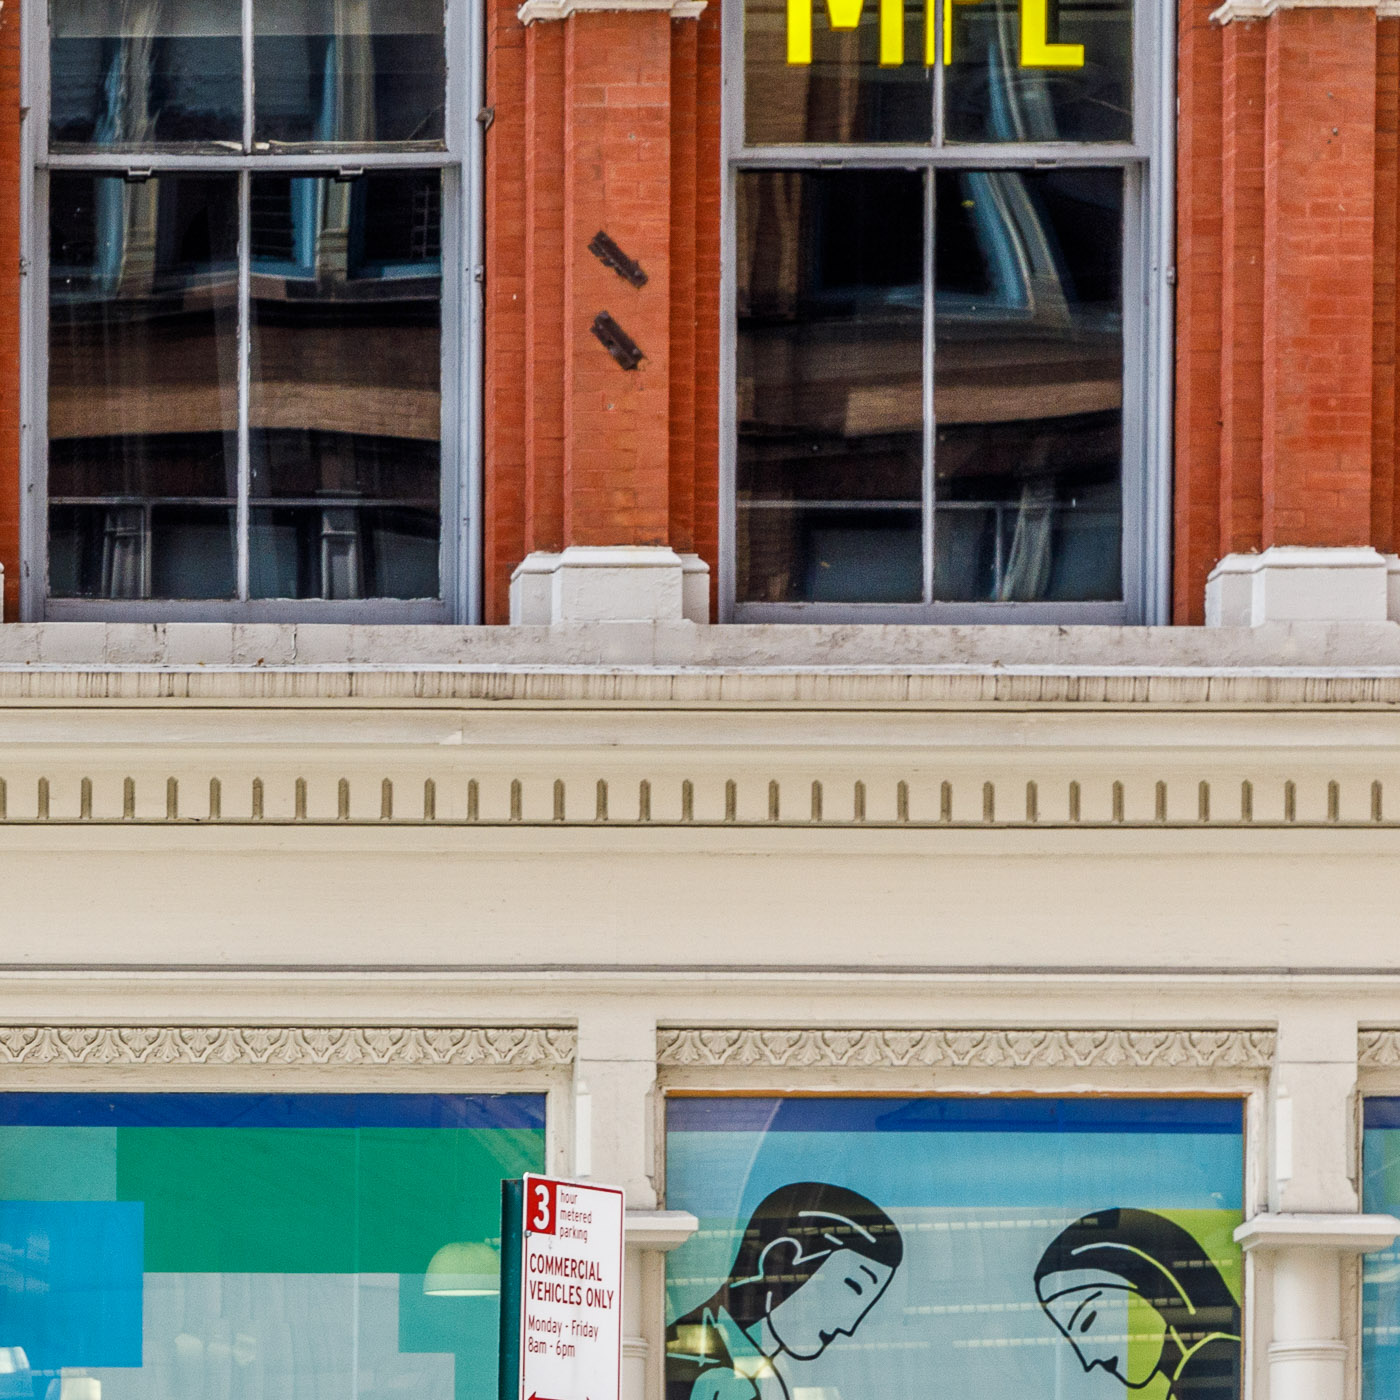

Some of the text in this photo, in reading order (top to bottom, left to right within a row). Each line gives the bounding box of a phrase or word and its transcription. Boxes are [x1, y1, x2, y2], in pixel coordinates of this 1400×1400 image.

[533, 1185, 550, 1230] 3
[560, 1189, 578, 1205] hour
[560, 1207, 592, 1224] metered
[559, 1225, 588, 1243] parking
[530, 1253, 602, 1282] COMMERCIAL
[530, 1281, 614, 1310] VEHICLES ONLY
[528, 1315, 563, 1338] Monday
[571, 1320, 599, 1342] Friday
[528, 1337, 547, 1354] 8am
[556, 1340, 576, 1360] 6pm
